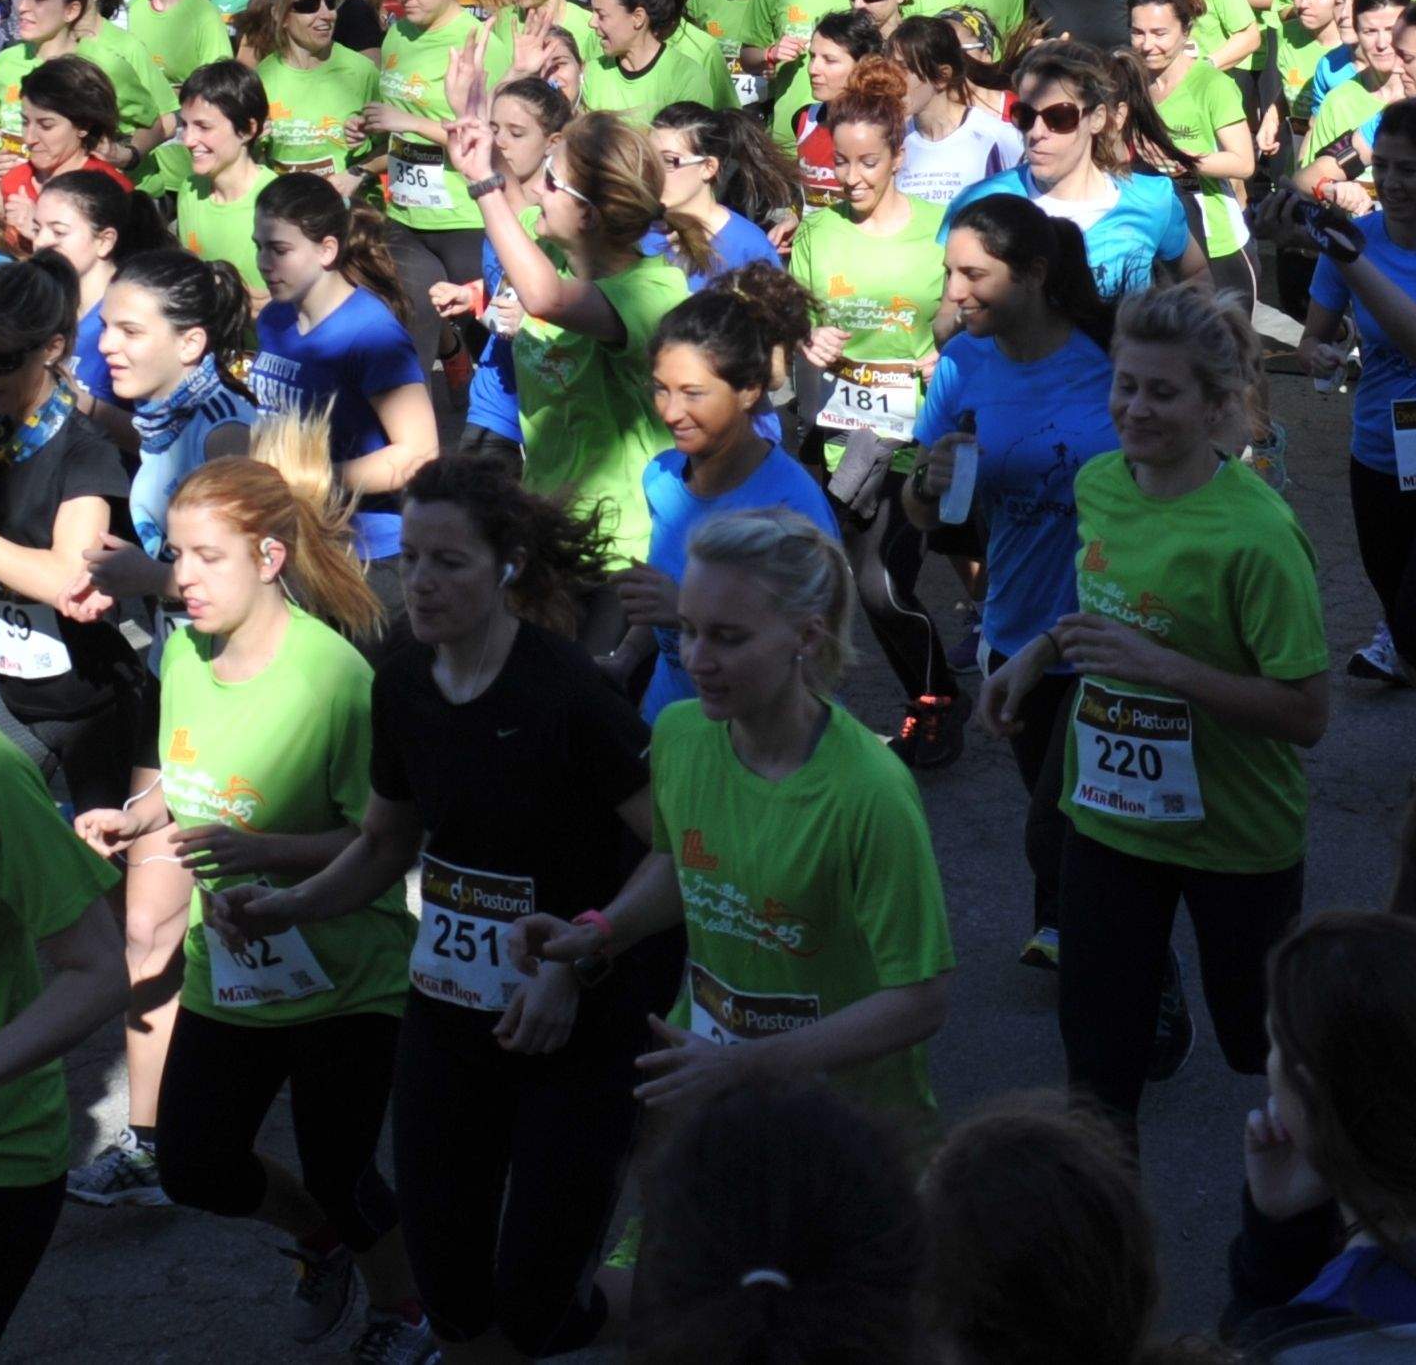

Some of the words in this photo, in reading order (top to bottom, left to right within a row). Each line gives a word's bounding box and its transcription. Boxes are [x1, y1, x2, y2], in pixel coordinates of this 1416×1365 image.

[395, 161, 428, 188] 356
[932, 190, 954, 200] 2012
[840, 385, 889, 413] 181
[1132, 709, 1187, 731] Pastora
[1095, 735, 1163, 781] 220
[472, 887, 530, 914] Pastora
[433, 913, 499, 967] 251
